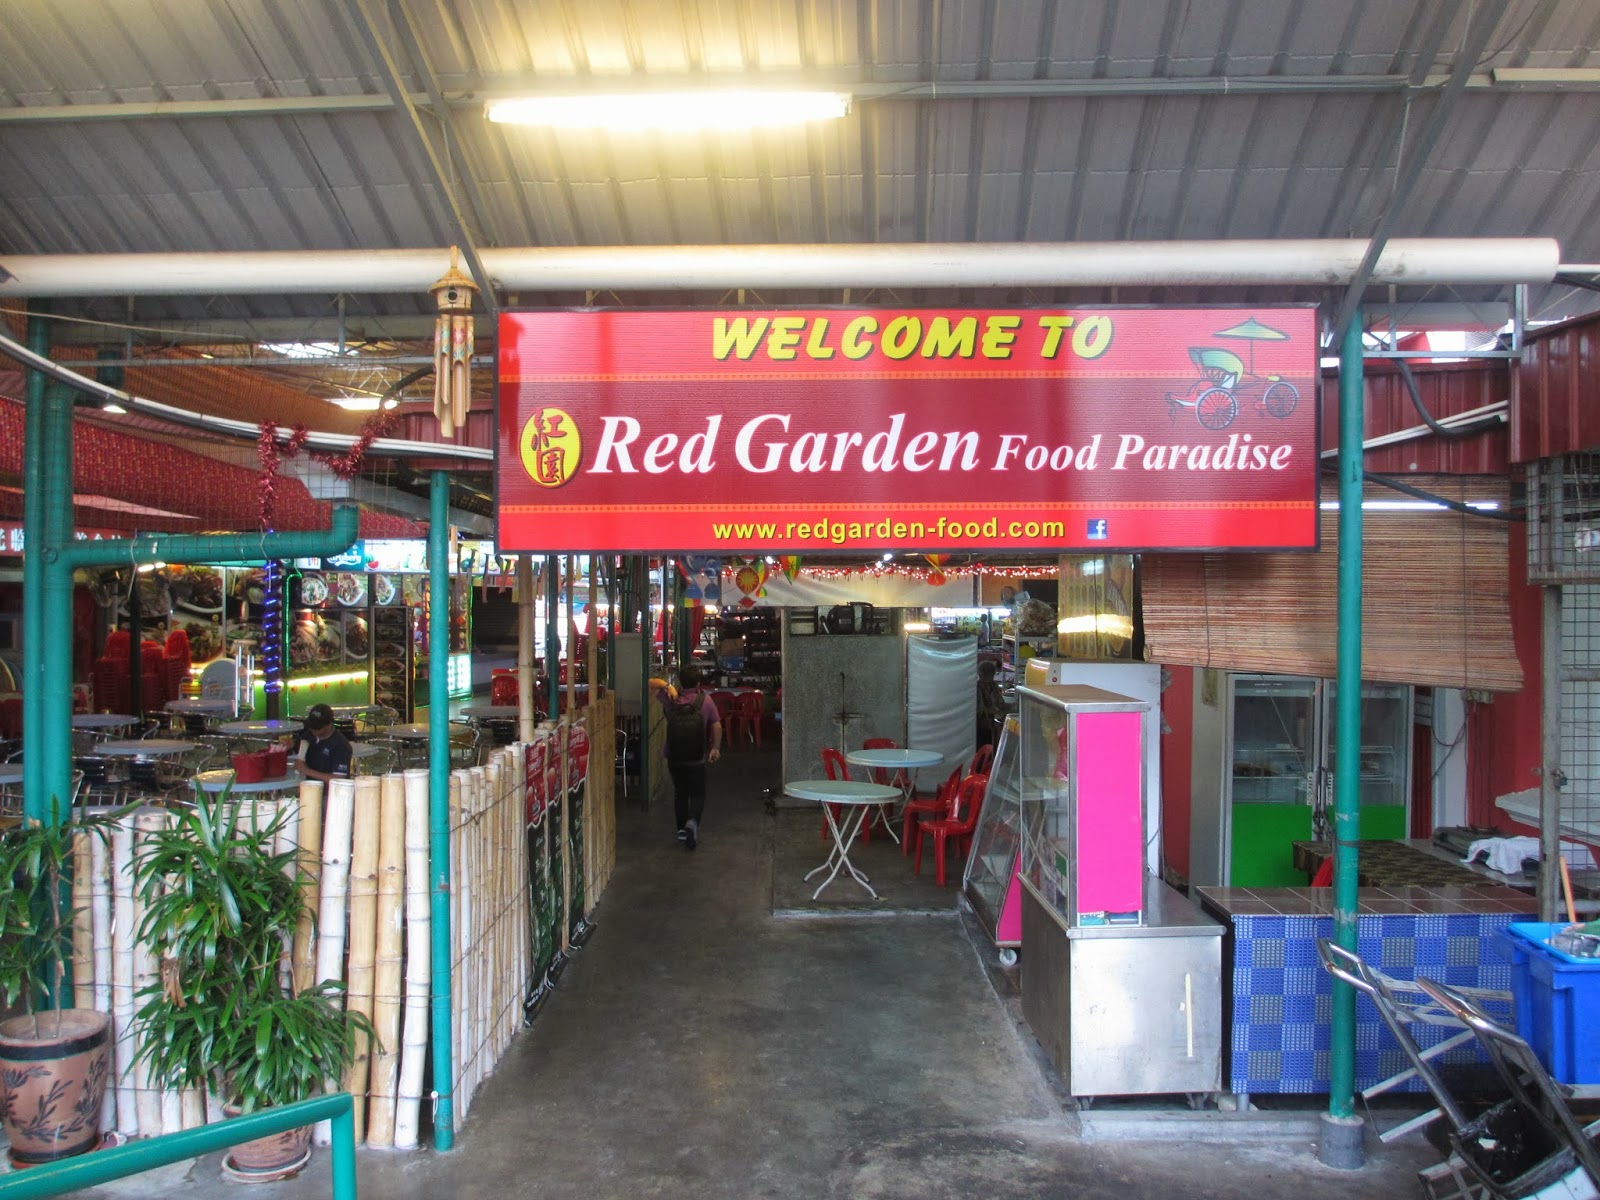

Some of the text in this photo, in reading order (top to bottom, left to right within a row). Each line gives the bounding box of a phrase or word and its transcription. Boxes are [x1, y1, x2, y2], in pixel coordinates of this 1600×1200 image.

[712, 315, 1113, 361] WELCOME TO
[531, 407, 568, 484] 紅園
[586, 413, 1293, 474] Red Garden Food Paradise
[712, 517, 1066, 546] www.redgarden-food.com
